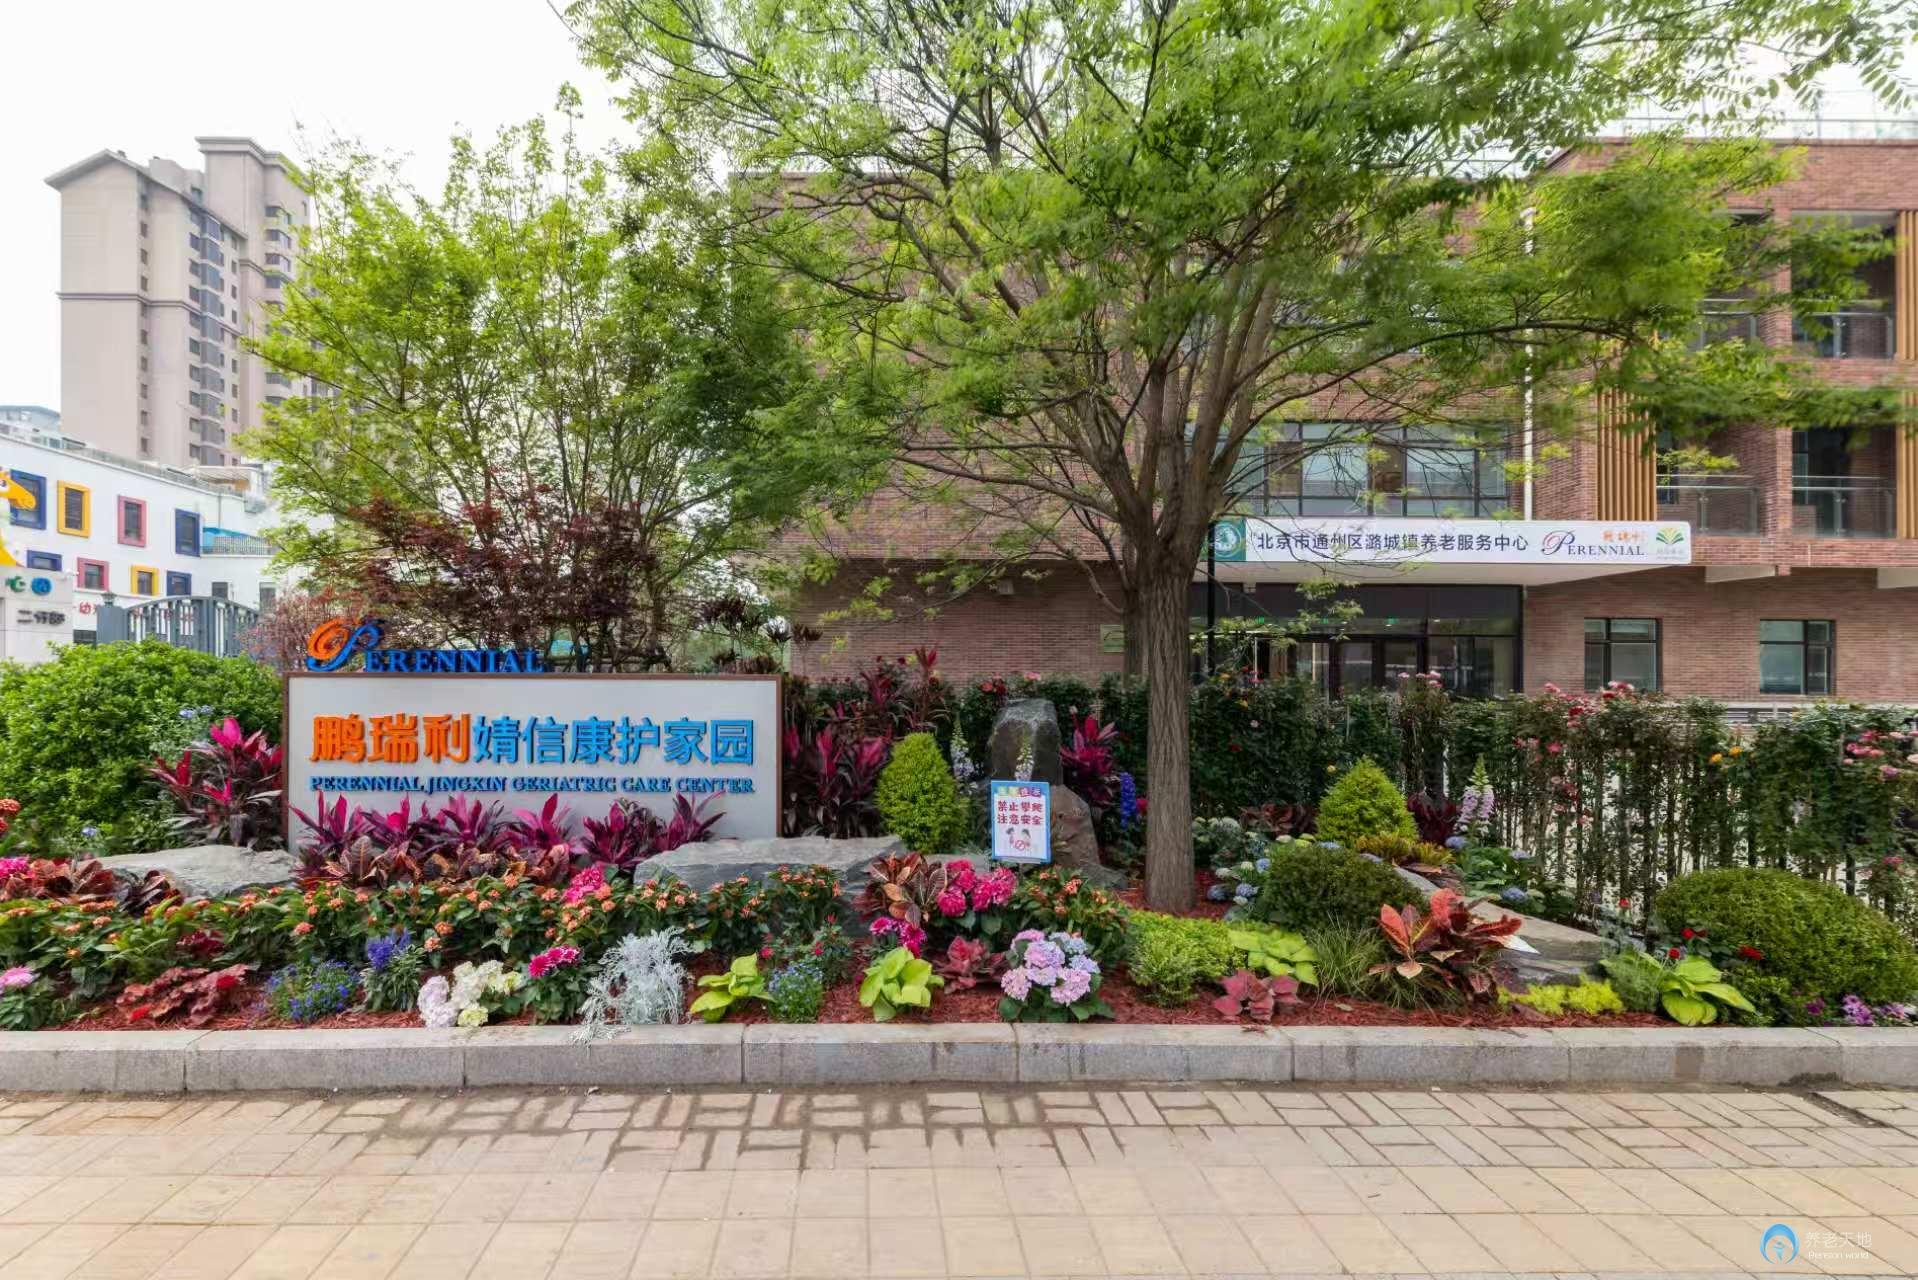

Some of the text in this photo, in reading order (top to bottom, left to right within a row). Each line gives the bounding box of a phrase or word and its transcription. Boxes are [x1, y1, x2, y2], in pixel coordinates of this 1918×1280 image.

[1257, 533, 1529, 552] 北京市通州区潞城镇养老服务中心
[1540, 528, 1645, 556] PERENNIAL
[305, 614, 544, 672] PERENNIAL
[308, 712, 759, 766] 鹏瑞利婧信康护家园
[310, 776, 756, 796] PERENNIAL JINGXIN GERIATRIC CARE CENTER
[997, 814, 1043, 826] 注意安全
